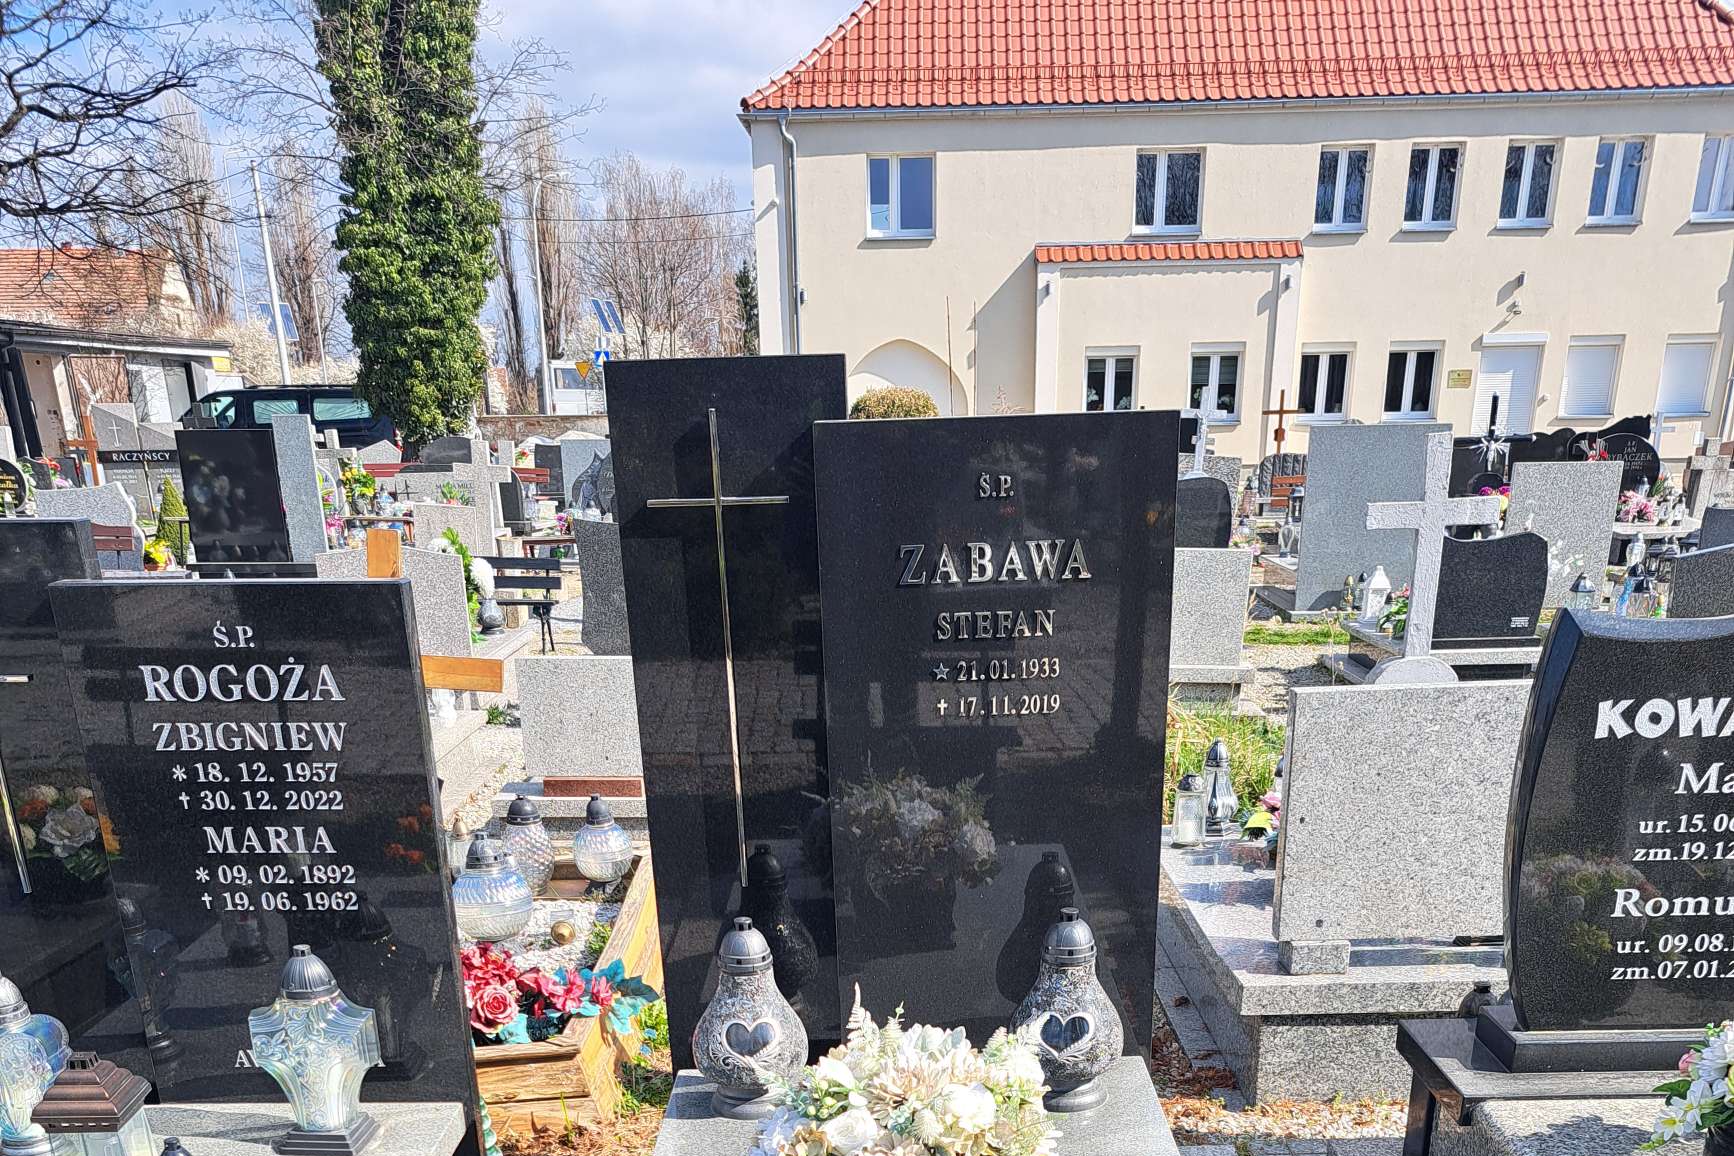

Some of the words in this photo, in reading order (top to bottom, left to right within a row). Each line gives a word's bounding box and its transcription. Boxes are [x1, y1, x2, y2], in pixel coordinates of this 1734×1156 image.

[112, 450, 171, 462] RACZYŃSCY
[979, 472, 1015, 498] Ś.P.
[899, 538, 1092, 585] ZABAWA
[212, 620, 255, 648] Ś.P.
[937, 609, 1056, 640] STEFAN
[138, 656, 346, 702] ROGOŻA
[152, 722, 347, 751] ZBIGNIEW
[282, 762, 338, 783] 1957
[284, 790, 344, 811] 2022
[1639, 820, 1671, 834] ur.
[202, 826, 338, 854] MARIA
[301, 864, 357, 884] 1892
[303, 891, 359, 912] 1962
[1616, 940, 1650, 953] ur.
